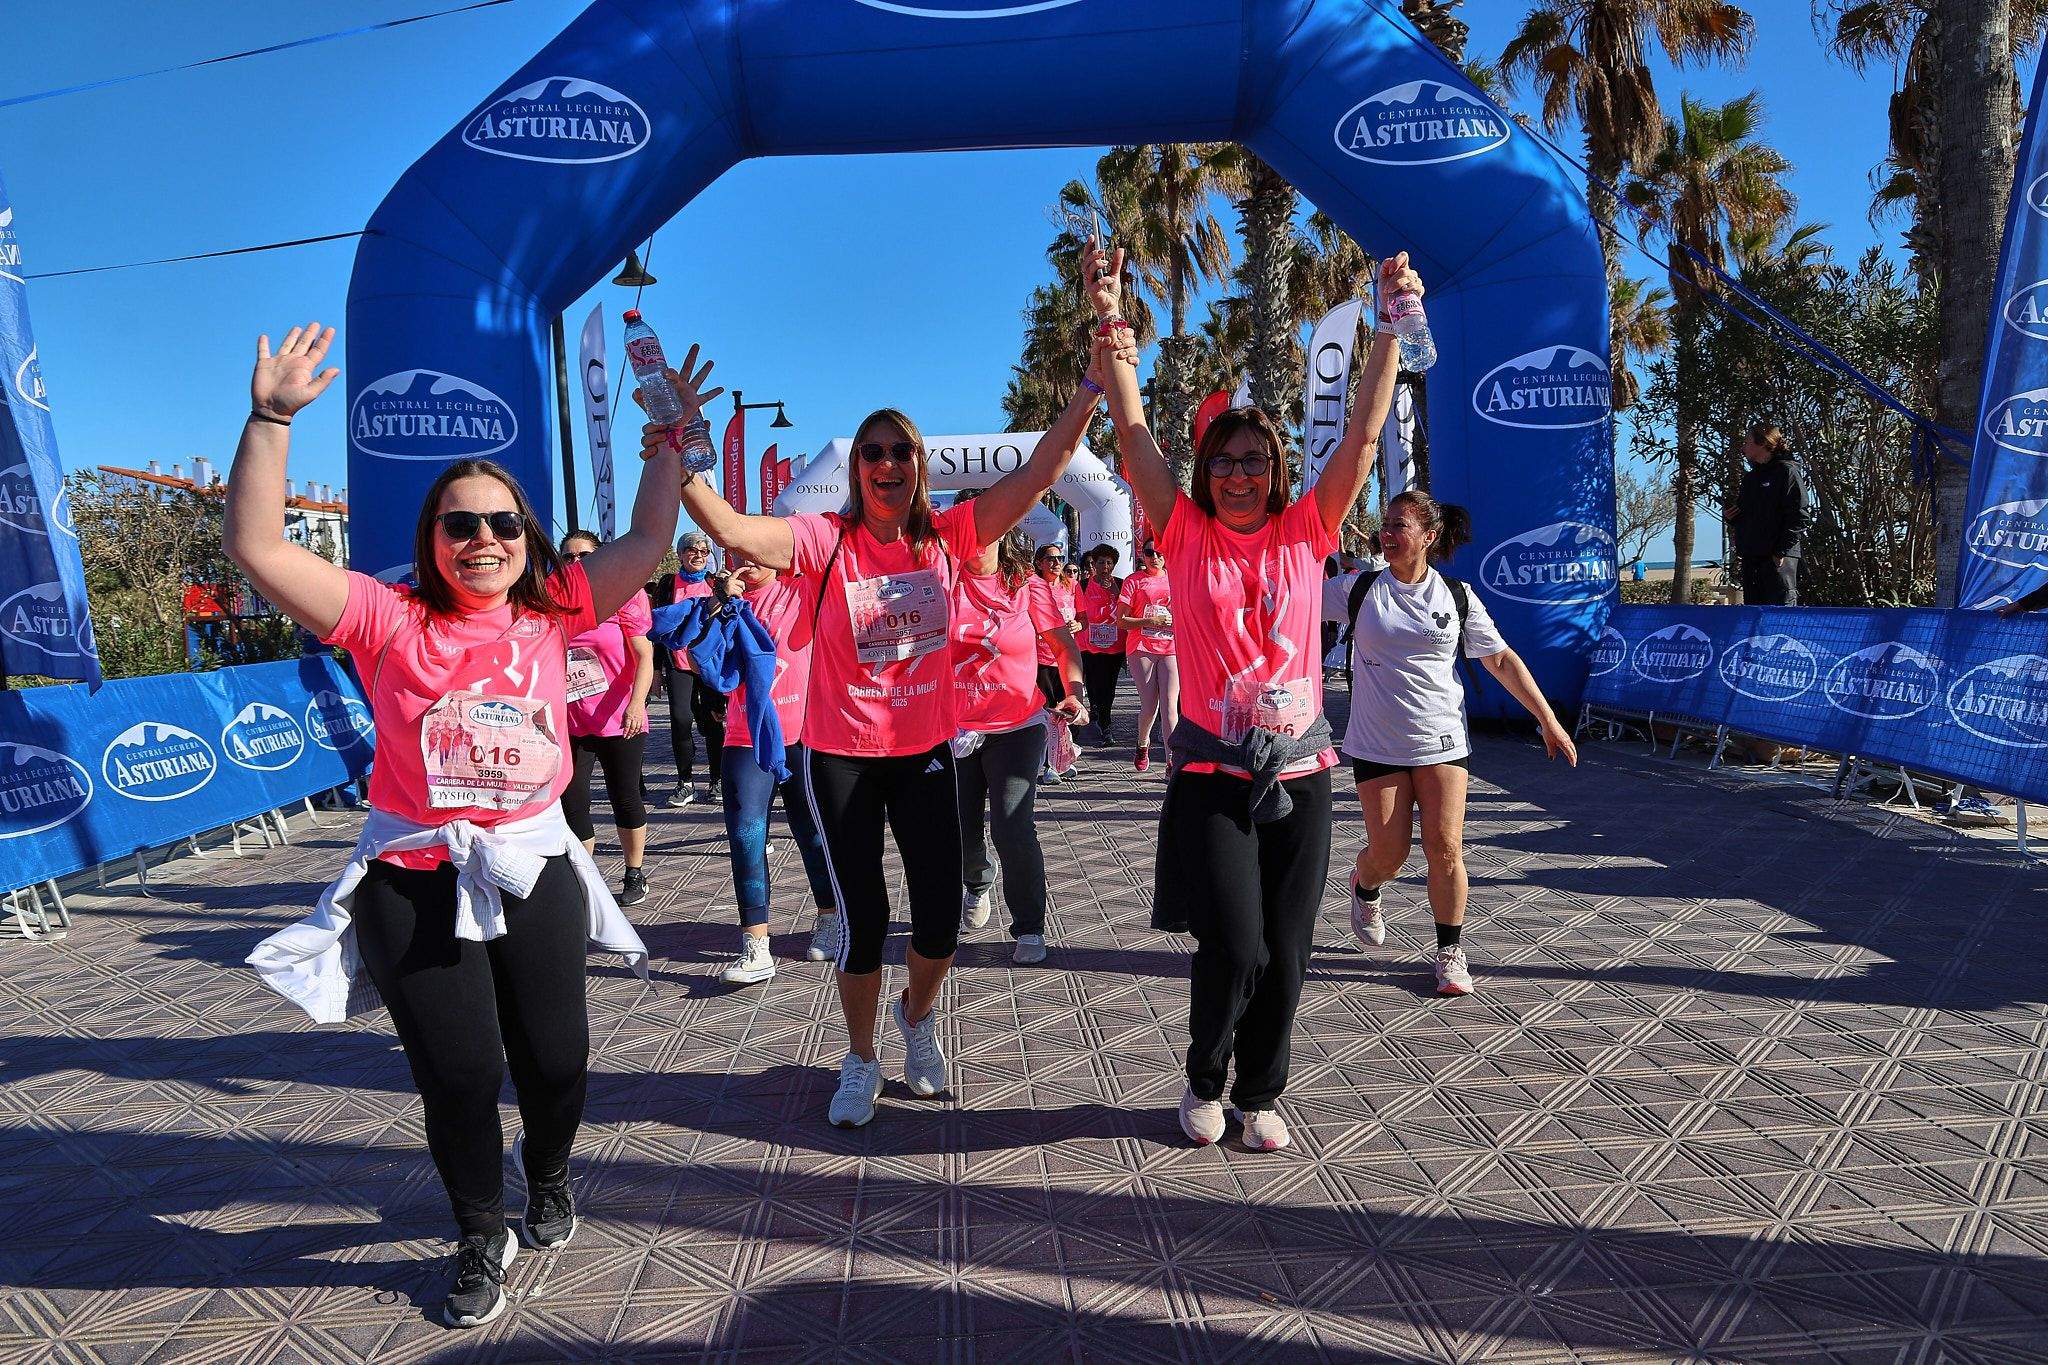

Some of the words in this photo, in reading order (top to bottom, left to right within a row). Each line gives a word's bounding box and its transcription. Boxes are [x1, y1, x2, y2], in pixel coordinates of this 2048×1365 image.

[503, 104, 561, 115] CENTRAL
[567, 104, 630, 116] LECHERA
[1378, 108, 1435, 120] CENTRAL
[1442, 107, 1491, 117] LECHERA
[472, 113, 637, 145] ASTURIANA
[1349, 116, 1503, 149] ASTURIANA
[1512, 374, 1569, 385] CENTRAL
[1485, 380, 1610, 412] ASTURIANA
[373, 401, 430, 410] CENTRAL
[436, 401, 500, 415] LECHERA
[355, 406, 507, 441] ASTURIANA
[732, 436, 740, 512] antander
[1064, 472, 1106, 484] OYSHO
[796, 484, 839, 494] OYSHO
[1089, 531, 1128, 541] OYSHO
[1519, 551, 1575, 560] CENTRAL
[1492, 556, 1617, 585] ASTURIANA
[11, 605, 74, 636] ASTU
[886, 610, 922, 628] 016
[896, 629, 912, 637] 3957
[869, 649, 897, 657] OYSHO
[1636, 644, 1706, 668] ASTURIANA
[1723, 651, 1807, 689] ASTURIANA
[848, 684, 888, 698] CARRERA
[890, 686, 902, 697] DE
[904, 685, 914, 696] LA
[984, 683, 1007, 691] MUJER
[891, 698, 908, 707] 2025
[473, 709, 519, 724] ASTURIANA
[126, 747, 164, 761] CENTRAL
[164, 741, 199, 754] LECHERA
[233, 730, 301, 760] ASTURIANA
[469, 745, 521, 765] 016
[24, 765, 71, 780] LECHERA
[115, 752, 212, 788] ASTURIANA
[478, 769, 503, 778] 3959
[435, 778, 467, 786] CARRERA
[0, 776, 86, 815] URIANA
